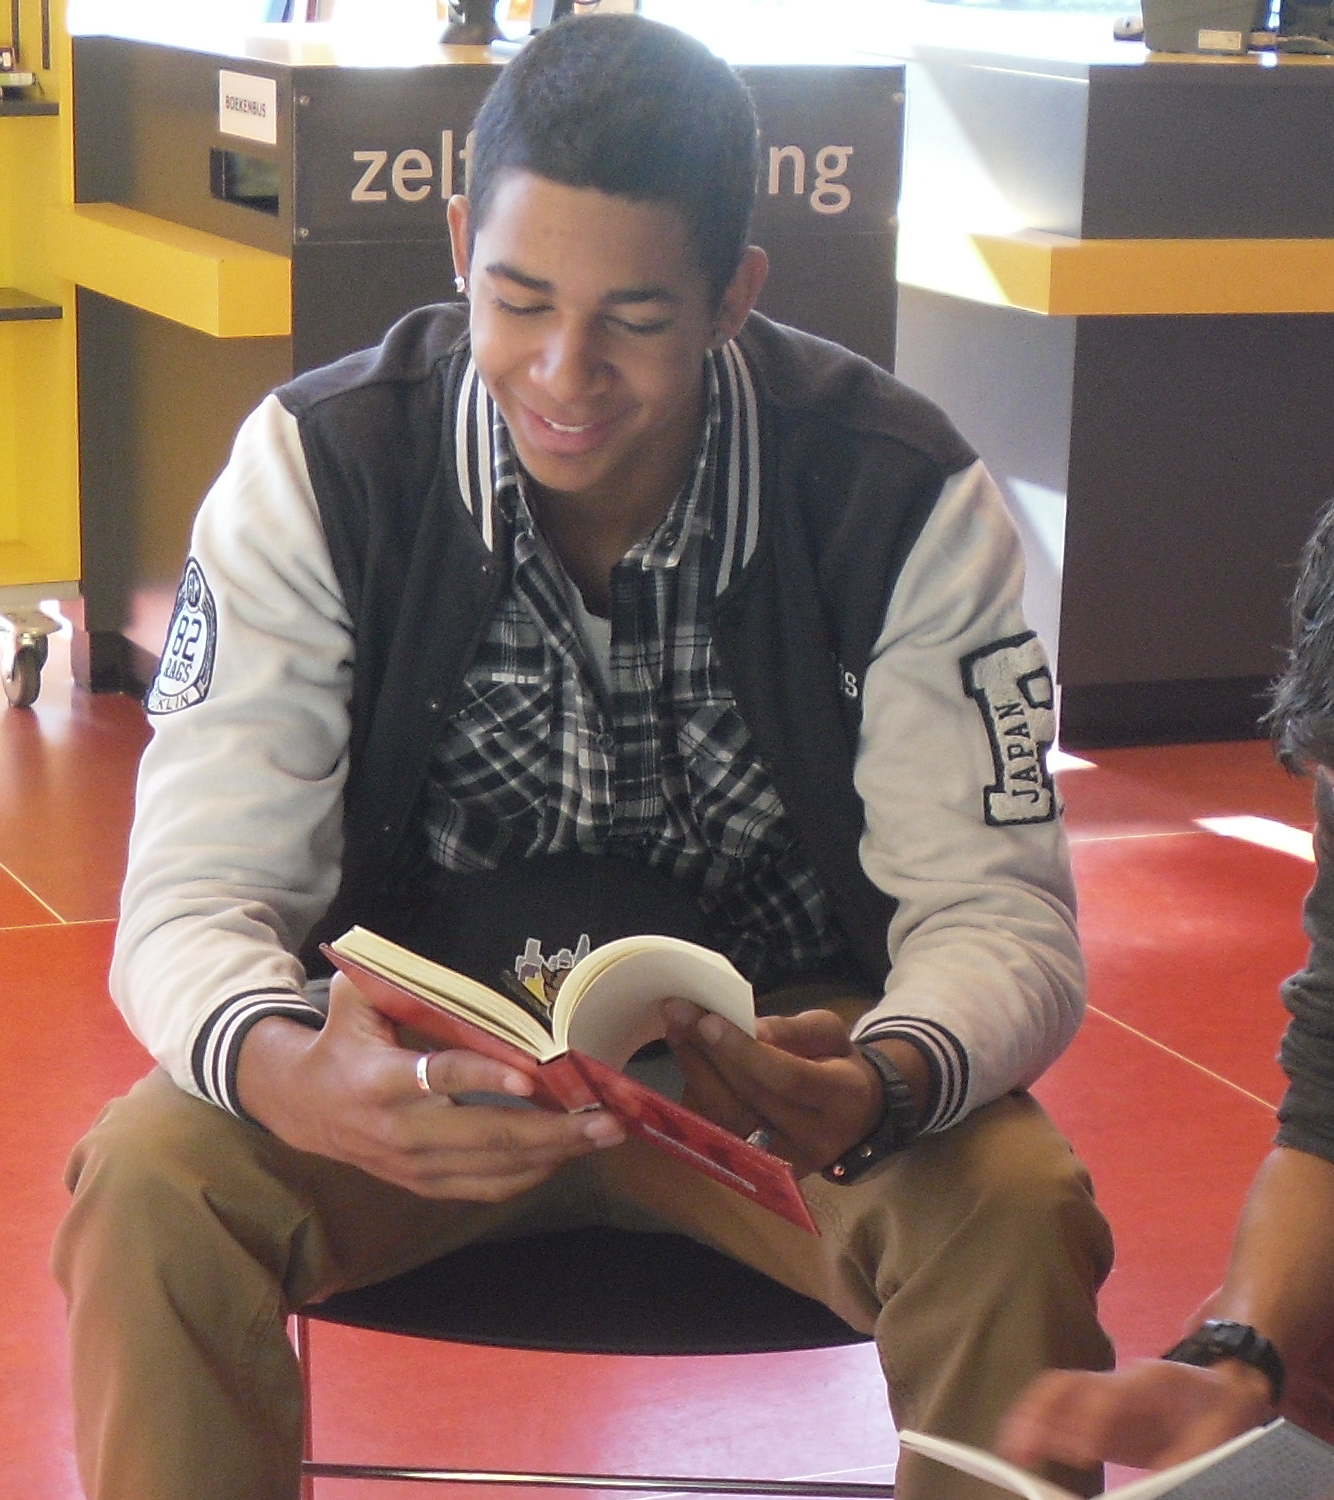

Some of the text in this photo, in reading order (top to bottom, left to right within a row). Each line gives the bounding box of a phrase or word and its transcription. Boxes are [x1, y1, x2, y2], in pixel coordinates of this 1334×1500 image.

[225, 94, 267, 118] BOEKENBUS
[767, 142, 854, 214] ng
[172, 614, 202, 662] 82
[163, 657, 193, 684] RAGS
[154, 692, 190, 711] KLIN
[994, 701, 1041, 804] JAPAN
